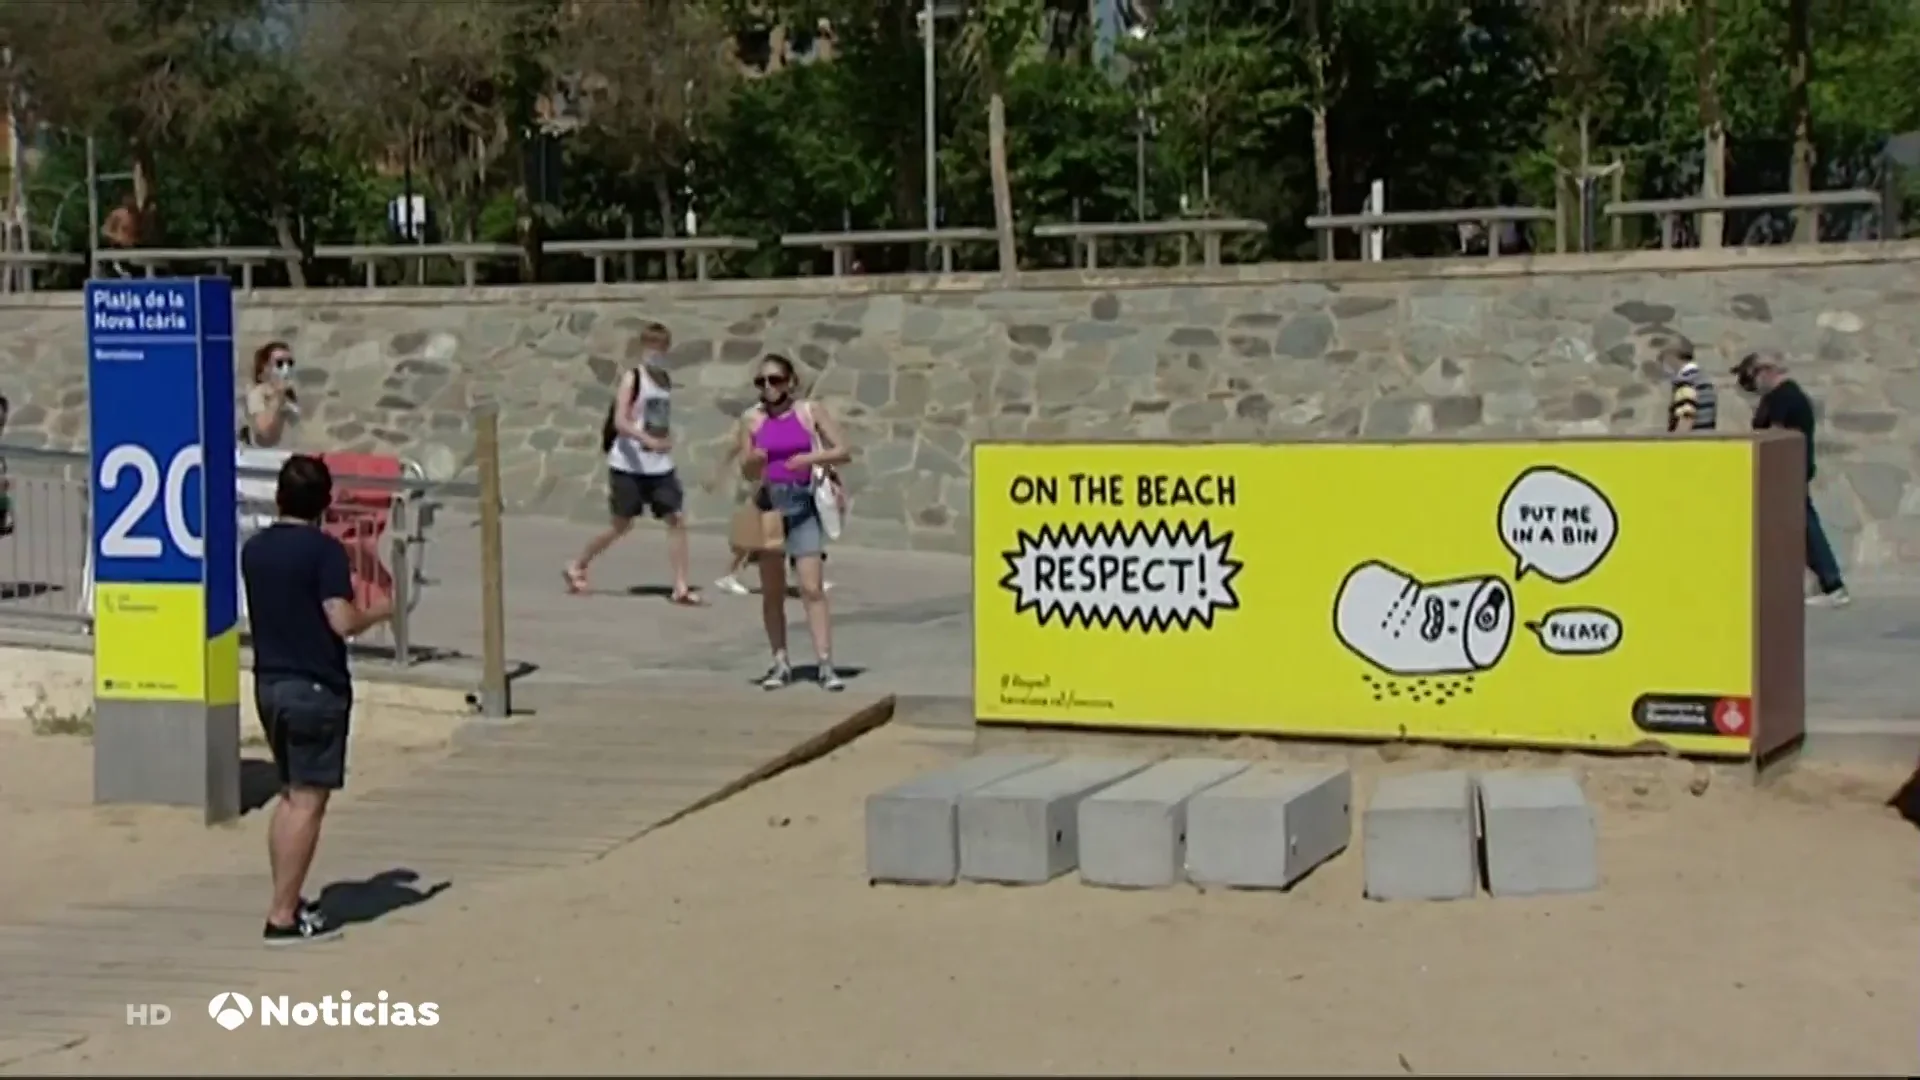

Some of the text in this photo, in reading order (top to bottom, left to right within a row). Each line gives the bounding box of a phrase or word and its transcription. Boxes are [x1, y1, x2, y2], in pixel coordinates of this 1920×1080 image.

[94, 289, 185, 311] Platja de la
[94, 311, 187, 329] Nova Icària
[1010, 473, 1236, 507] ON THE BEACH
[100, 443, 204, 559] 20
[1519, 504, 1591, 524] PUT ME
[1512, 526, 1599, 545] IN A BIN
[1034, 553, 1207, 599] RESPECT!
[1551, 621, 1609, 641] PLEASE
